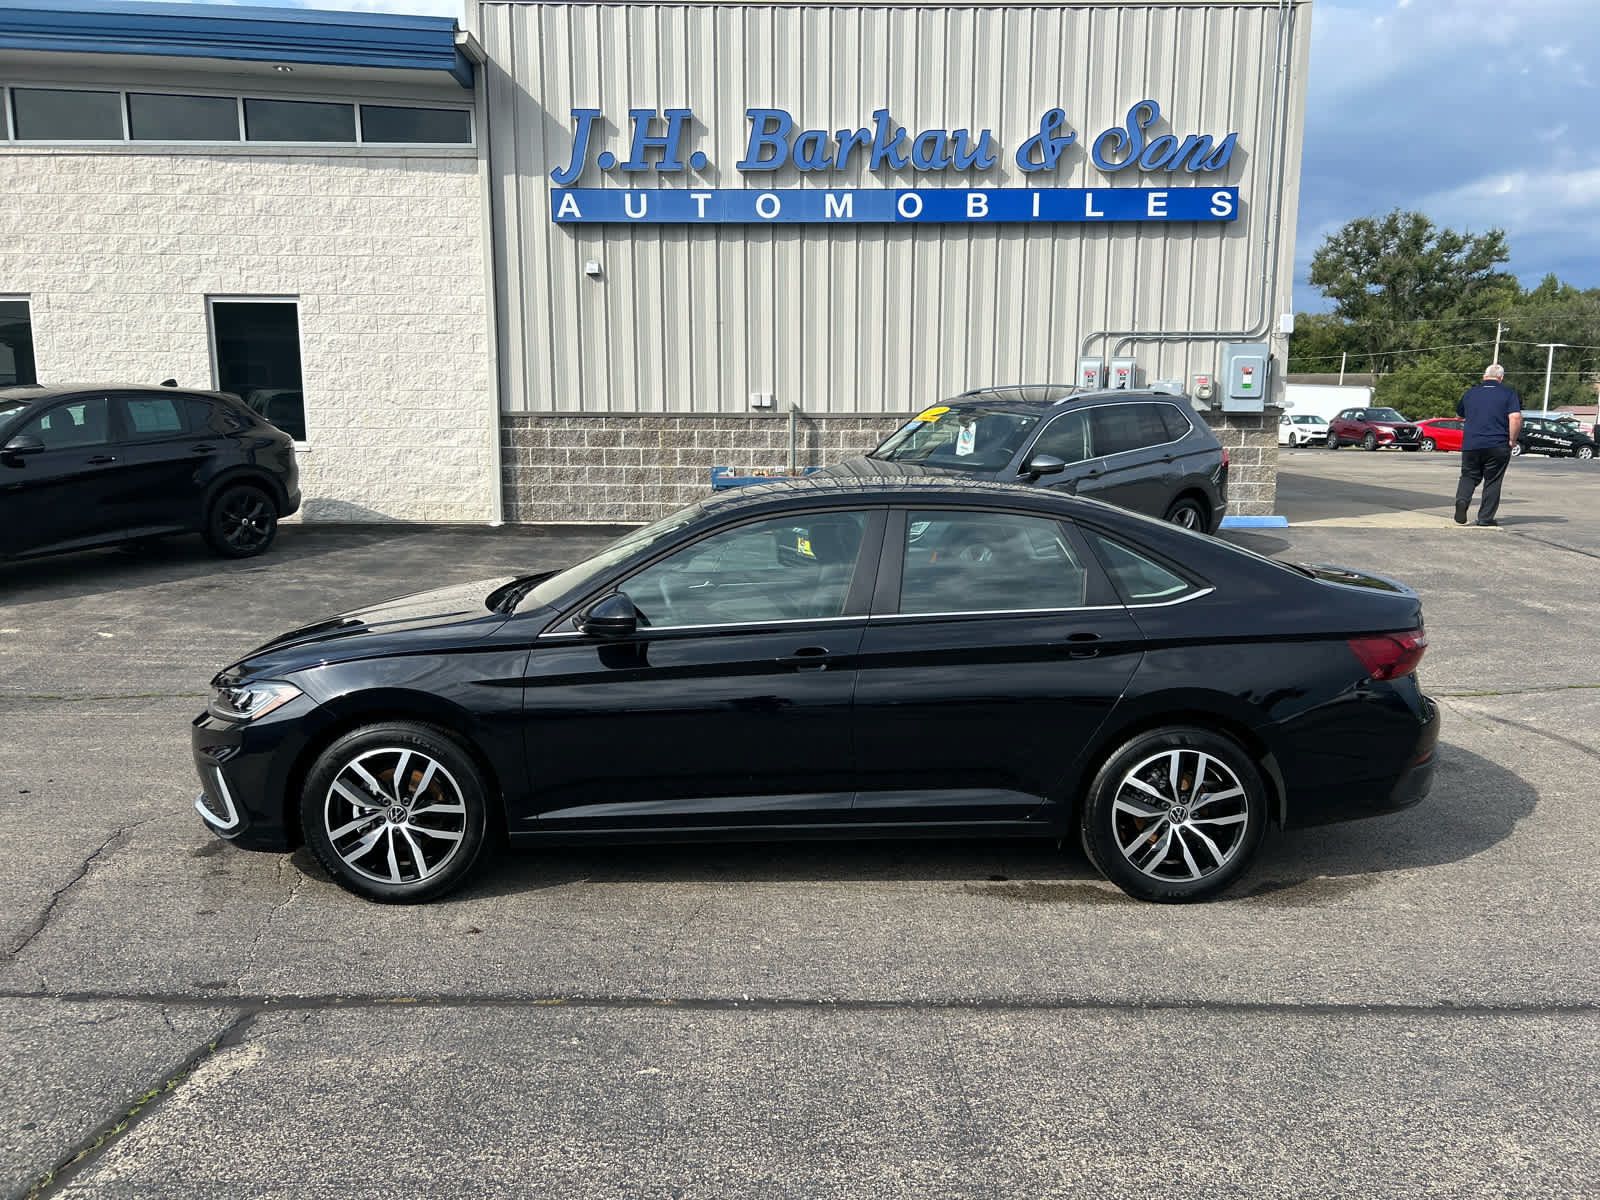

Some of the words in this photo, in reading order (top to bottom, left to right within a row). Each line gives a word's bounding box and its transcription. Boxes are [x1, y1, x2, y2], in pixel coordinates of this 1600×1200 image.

[550, 108, 708, 186] J.H.
[735, 107, 998, 172] Barkau
[1015, 107, 1076, 173] &
[1091, 99, 1239, 173] Sons
[557, 191, 1233, 218] AUTOMOBILES
